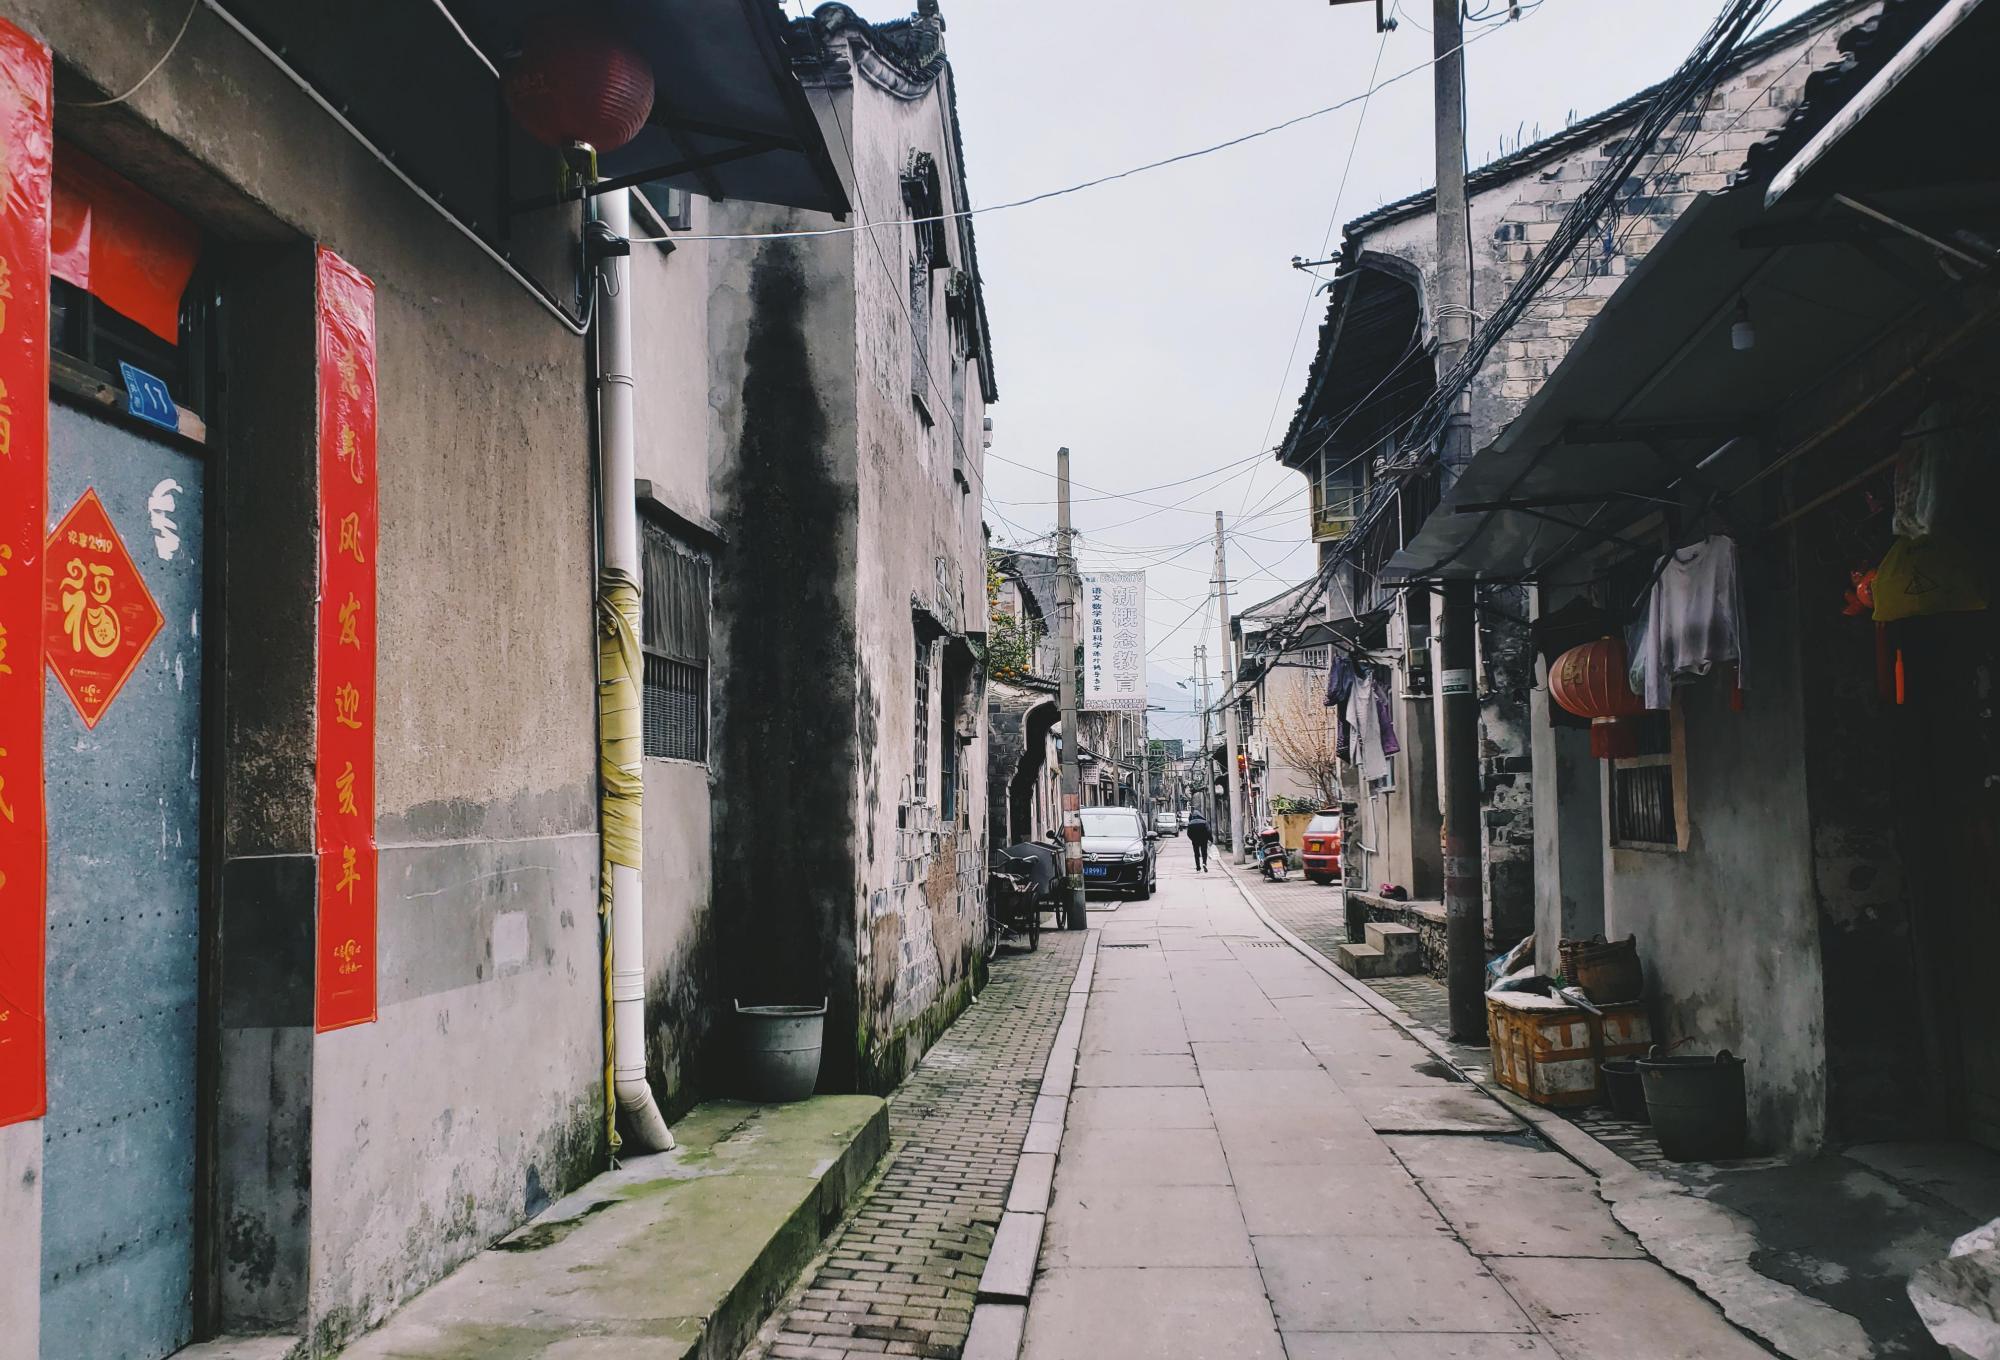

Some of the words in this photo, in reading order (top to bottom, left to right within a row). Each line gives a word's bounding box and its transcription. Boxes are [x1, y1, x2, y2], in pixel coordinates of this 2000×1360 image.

[144, 382, 168, 415] 17
[59, 557, 121, 658] 福
[1112, 586, 1139, 692] 新概念教育
